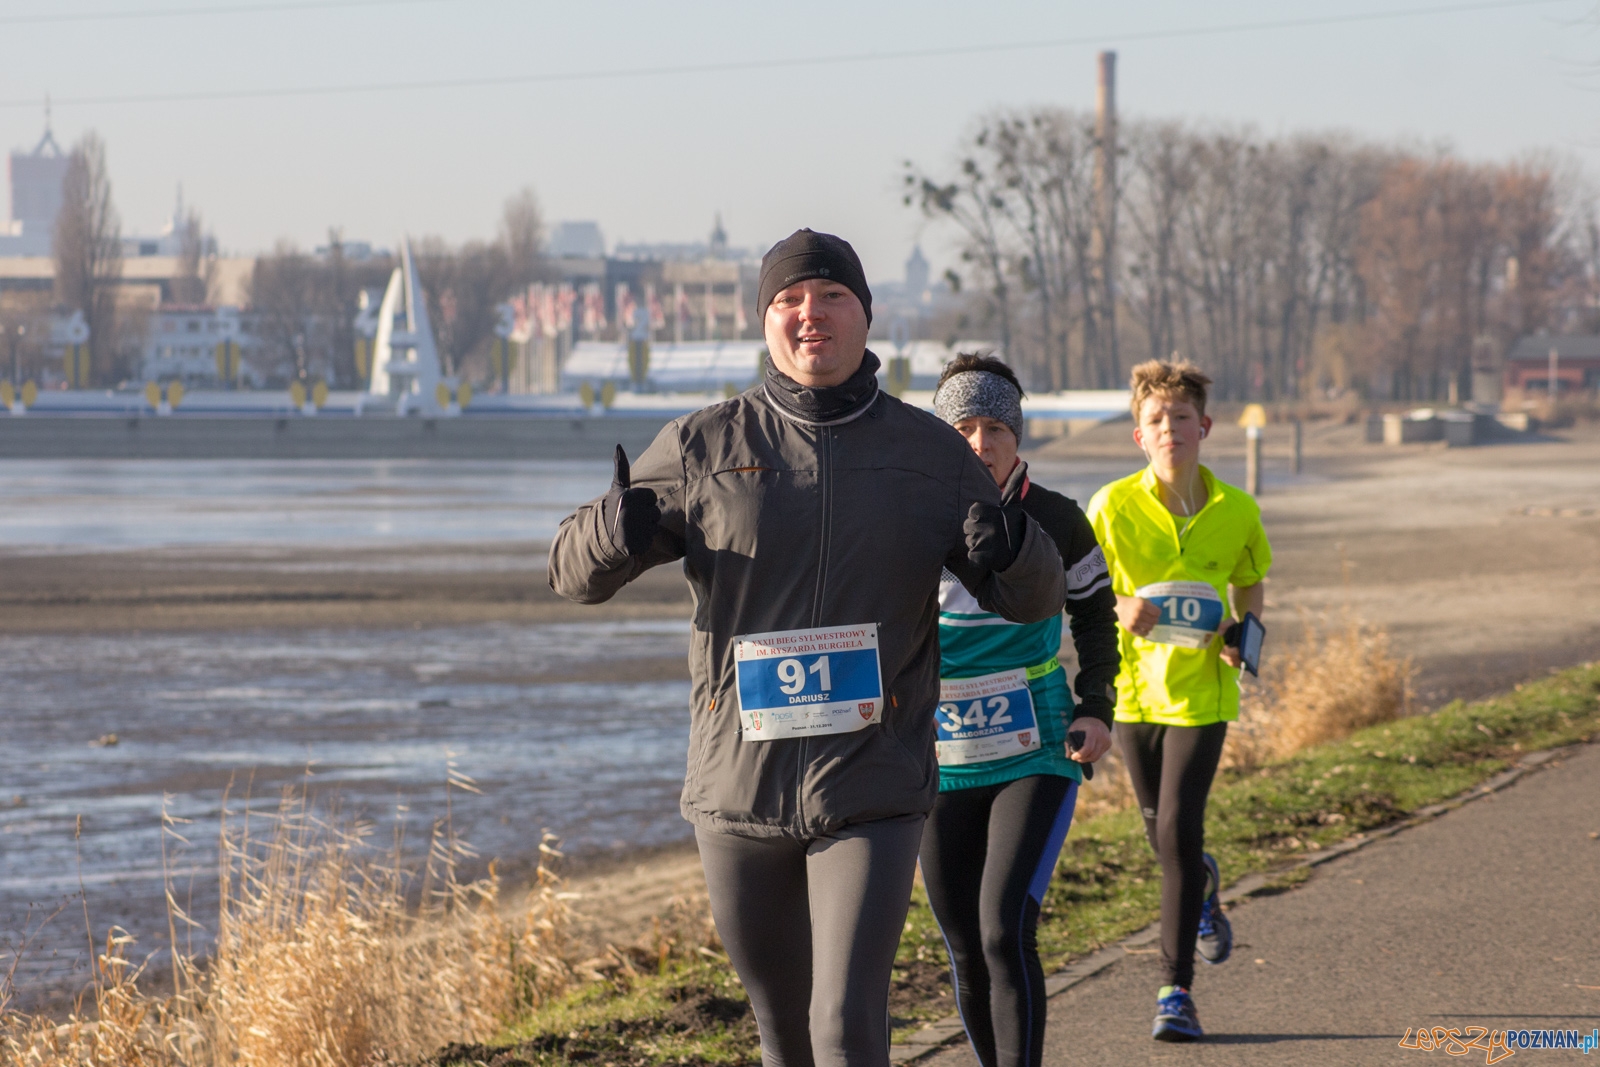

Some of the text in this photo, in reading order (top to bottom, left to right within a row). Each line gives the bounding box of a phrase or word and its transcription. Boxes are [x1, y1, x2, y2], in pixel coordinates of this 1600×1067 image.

[1163, 596, 1201, 621] 10
[752, 629, 867, 647] XXXII BIEG SYLWESTROWY
[756, 648, 769, 657] IM.
[770, 643, 817, 656] RYSZARDA
[818, 639, 864, 650] BURGIELA
[777, 655, 832, 695] 91
[965, 673, 1019, 689] SYLWESTROWY
[788, 693, 830, 704] DARIUSZ
[940, 695, 1013, 732] 342
